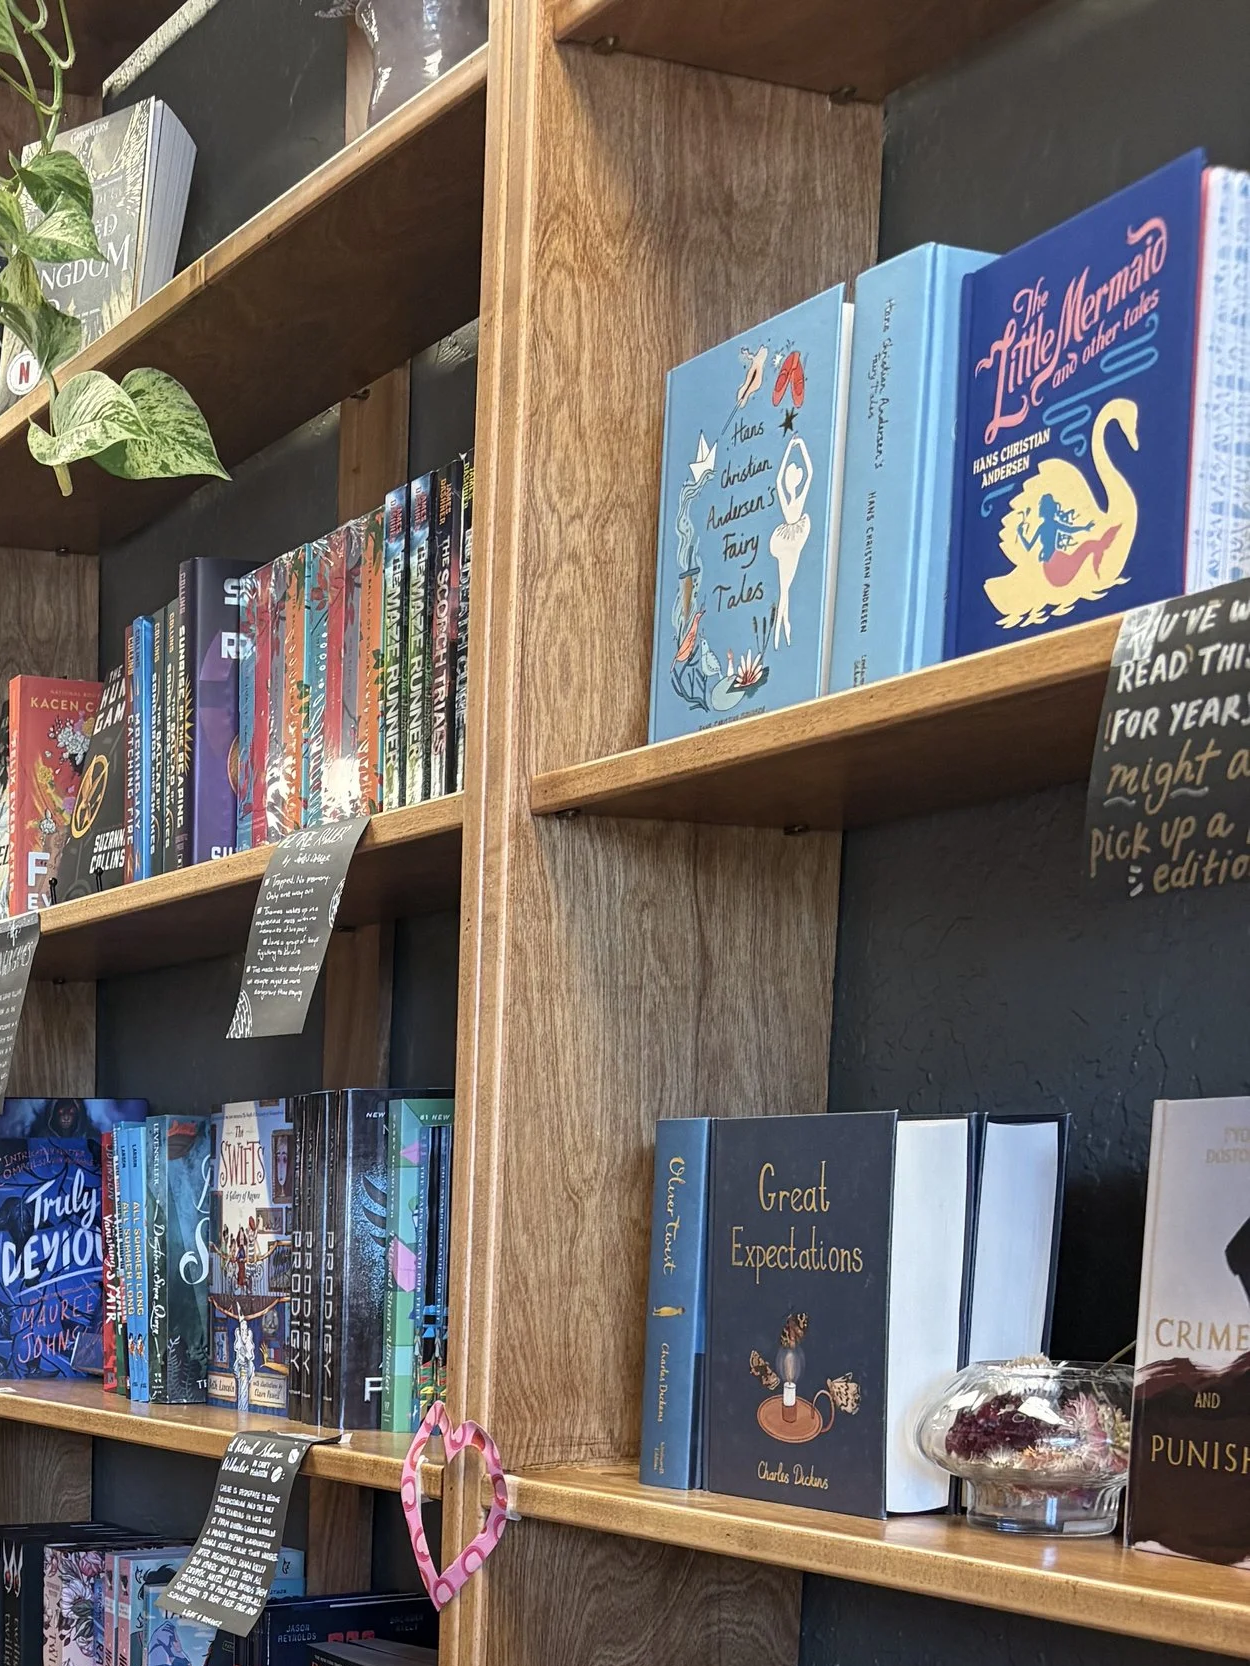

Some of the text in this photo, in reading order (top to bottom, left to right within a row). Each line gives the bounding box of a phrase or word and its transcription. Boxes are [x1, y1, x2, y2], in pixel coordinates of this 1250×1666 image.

[883, 298, 896, 333] Hans
[1013, 276, 1049, 328] The
[975, 216, 1167, 444] Little Mermaid
[1052, 289, 1159, 388] and other tales
[19, 361, 30, 384] N
[880, 338, 893, 394] Christian
[731, 421, 764, 442] Hans
[973, 428, 1050, 474] HANS CHRISTIAN
[721, 457, 772, 489] Christian
[982, 456, 1030, 488] ANDERSEN
[707, 486, 776, 530] Andersen's
[723, 534, 760, 568] Fairy
[860, 491, 876, 633] HANS CHRISTIAN ANDERSEN
[713, 573, 764, 612] Tales
[109, 665, 123, 681] THE
[178, 625, 186, 701] SUNRISE
[385, 588, 401, 769] MAZE RUNNER
[409, 578, 425, 763] MAZE RUNNER
[432, 569, 449, 756] SCORCH TRIALS
[1116, 656, 1188, 694] READ
[31, 697, 79, 710] KACEN
[1111, 706, 1159, 746] FOR
[1106, 739, 1221, 815] might
[1161, 815, 1196, 861] up
[1207, 812, 1234, 838] a
[90, 850, 125, 874] COLLINS
[235, 1126, 244, 1137] The
[105, 1144, 114, 1201] JOHNSON
[220, 1141, 265, 1187] SWIFTS
[758, 1160, 830, 1213] Great
[26, 1169, 99, 1230] Truly
[663, 1156, 686, 1276] Oliver Twist
[124, 1228, 132, 1280] SUMMER
[133, 1202, 142, 1280] ALL SUMMER
[731, 1226, 864, 1284] Expectations
[290, 1230, 302, 1371] PRODIGY
[303, 1231, 313, 1379] PRODIGY
[324, 1231, 335, 1378] PRODIGY
[1155, 1318, 1250, 1352] CRIME
[657, 1342, 670, 1423] Charles Dickens
[1194, 1392, 1221, 1409] AND
[757, 1461, 830, 1490] Charles Dickens
[277, 1633, 317, 1644] REYNOLDS
[285, 1624, 311, 1634] JASON
